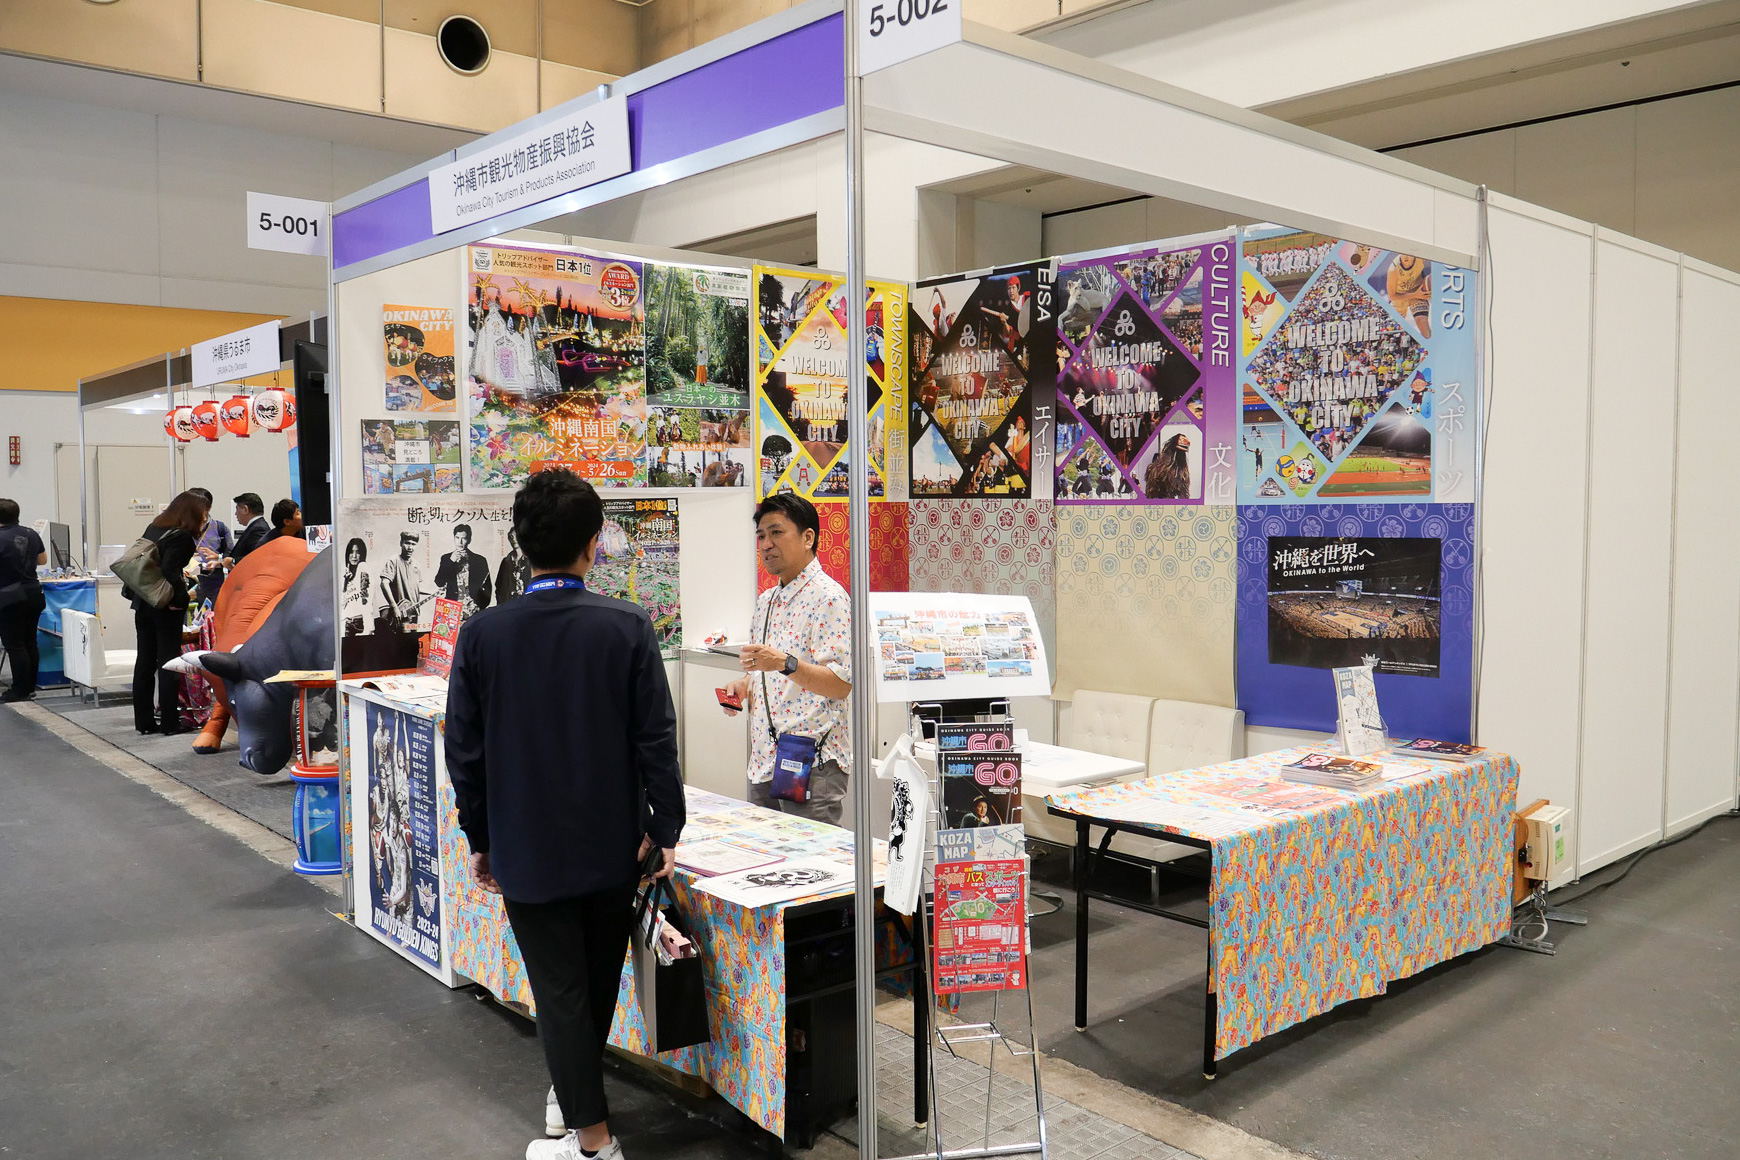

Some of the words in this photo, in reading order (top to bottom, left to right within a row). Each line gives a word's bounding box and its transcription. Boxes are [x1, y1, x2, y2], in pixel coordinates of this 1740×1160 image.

[453, 121, 596, 197] 沖縄市観光物産振興協会
[456, 202, 481, 217] Okinawa
[482, 197, 495, 212] City
[496, 189, 518, 205] Tourism
[519, 187, 525, 196] &
[525, 176, 554, 195] Products
[555, 161, 596, 187] Association
[259, 212, 318, 238] 5-001
[497, 253, 548, 262] トリップアドバイザー
[556, 258, 592, 276] 日本1位
[1037, 267, 1051, 323] EISA
[383, 309, 454, 322] OKINAWA
[1210, 244, 1230, 368] CULTURE
[420, 321, 454, 332] CITY
[1288, 317, 1382, 350] WELCOME
[890, 291, 904, 423] TOWNSCAPE
[941, 353, 1000, 376] WELCOME
[1091, 341, 1162, 368] WELCOME
[1320, 350, 1344, 373] TO
[791, 356, 848, 377] WELCOM
[686, 384, 716, 393] 日本一の
[815, 380, 832, 399] TO
[960, 375, 975, 395] TO
[1116, 370, 1135, 390] TO
[1289, 376, 1379, 403] OKINAWA
[663, 393, 741, 406] ユスラヤシ並木
[942, 398, 1000, 419] OKINAWA
[1092, 391, 1160, 416] OKINAWA
[791, 403, 848, 420] OKINAW
[1312, 405, 1356, 429] CITY
[550, 418, 617, 438] 沖縄南国
[807, 424, 839, 443] CITY
[955, 420, 981, 440] CITY
[1110, 419, 1142, 439] CITY
[520, 438, 645, 458] イルミネーション
[1034, 405, 1052, 494] エイサー
[1438, 382, 1466, 497] スポーツ
[888, 428, 905, 497] 街並み
[1208, 442, 1232, 499] 文化
[408, 506, 513, 526] 断ち切れクソ人生を!
[1273, 542, 1375, 571] 沖縄を世界へ
[1283, 568, 1317, 578] OKINAWA
[1318, 567, 1327, 575] to
[1328, 565, 1341, 574] the
[1342, 563, 1365, 573] World
[968, 733, 1010, 751] GO
[974, 762, 1018, 786] GO
[939, 833, 972, 846] KOZA
[943, 846, 968, 859] MAP
[967, 872, 984, 882] バス
[417, 915, 439, 939] 2023-24
[419, 934, 438, 962] KINGS
